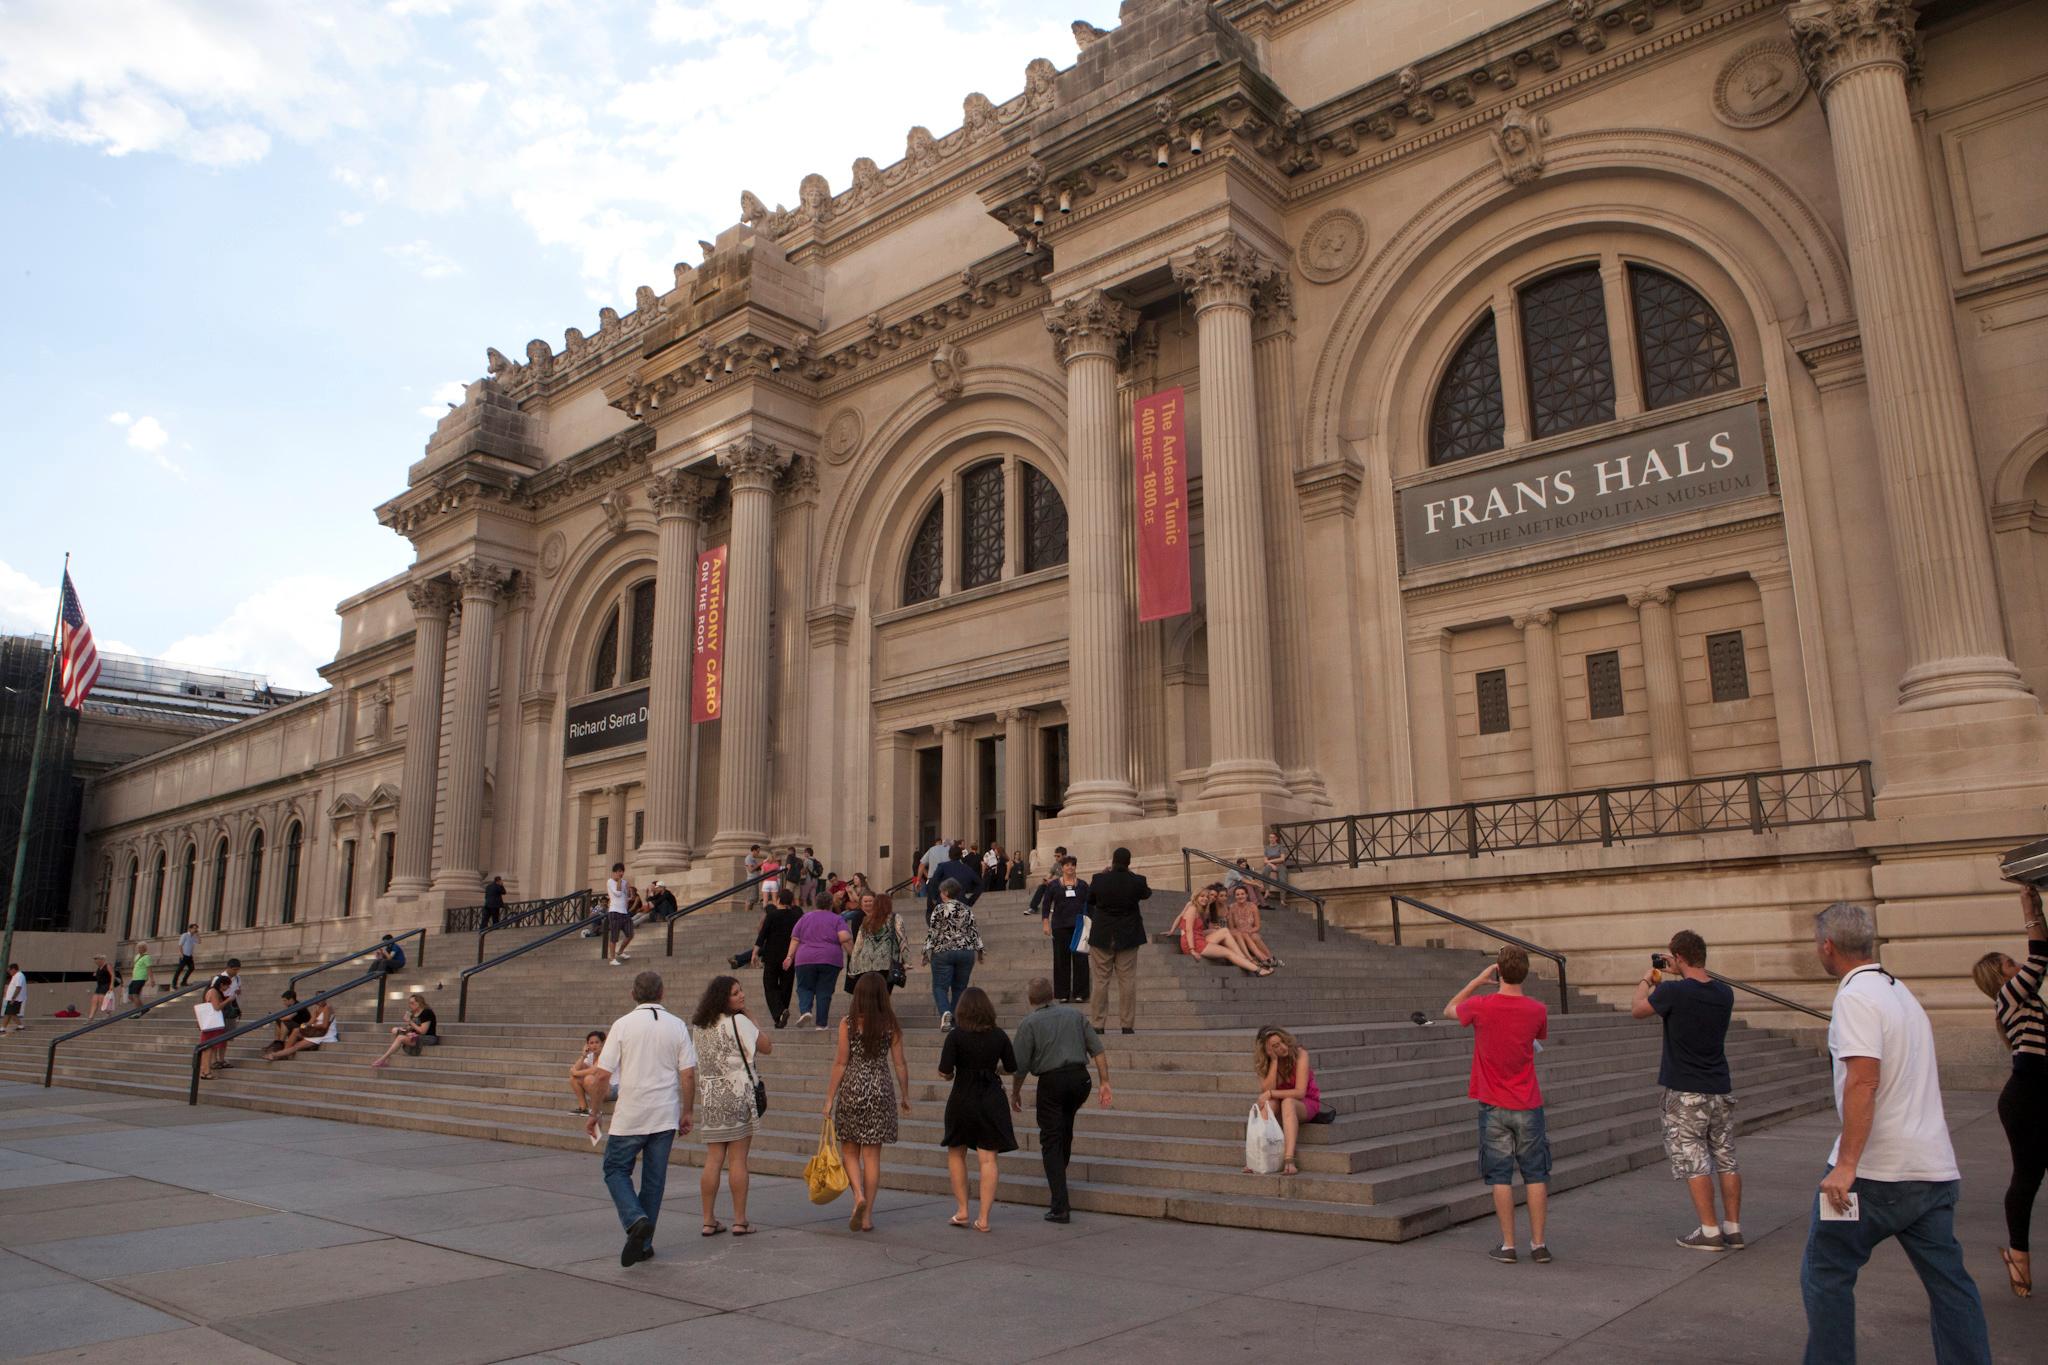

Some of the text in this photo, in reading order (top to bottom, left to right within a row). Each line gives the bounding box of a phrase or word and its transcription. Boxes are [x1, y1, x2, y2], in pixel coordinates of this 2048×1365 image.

[1141, 408, 1155, 435] 400
[1162, 399, 1180, 545] The Andean Tunic
[1424, 431, 1735, 534] FRANS HALS
[1455, 474, 1752, 550] IN THE METROPOLITAN MUSEUM
[697, 561, 709, 654] ON THE ROOF
[706, 558, 722, 714] ANTHONY CARO
[570, 716, 607, 739] Richard
[608, 712, 636, 730] Serra
